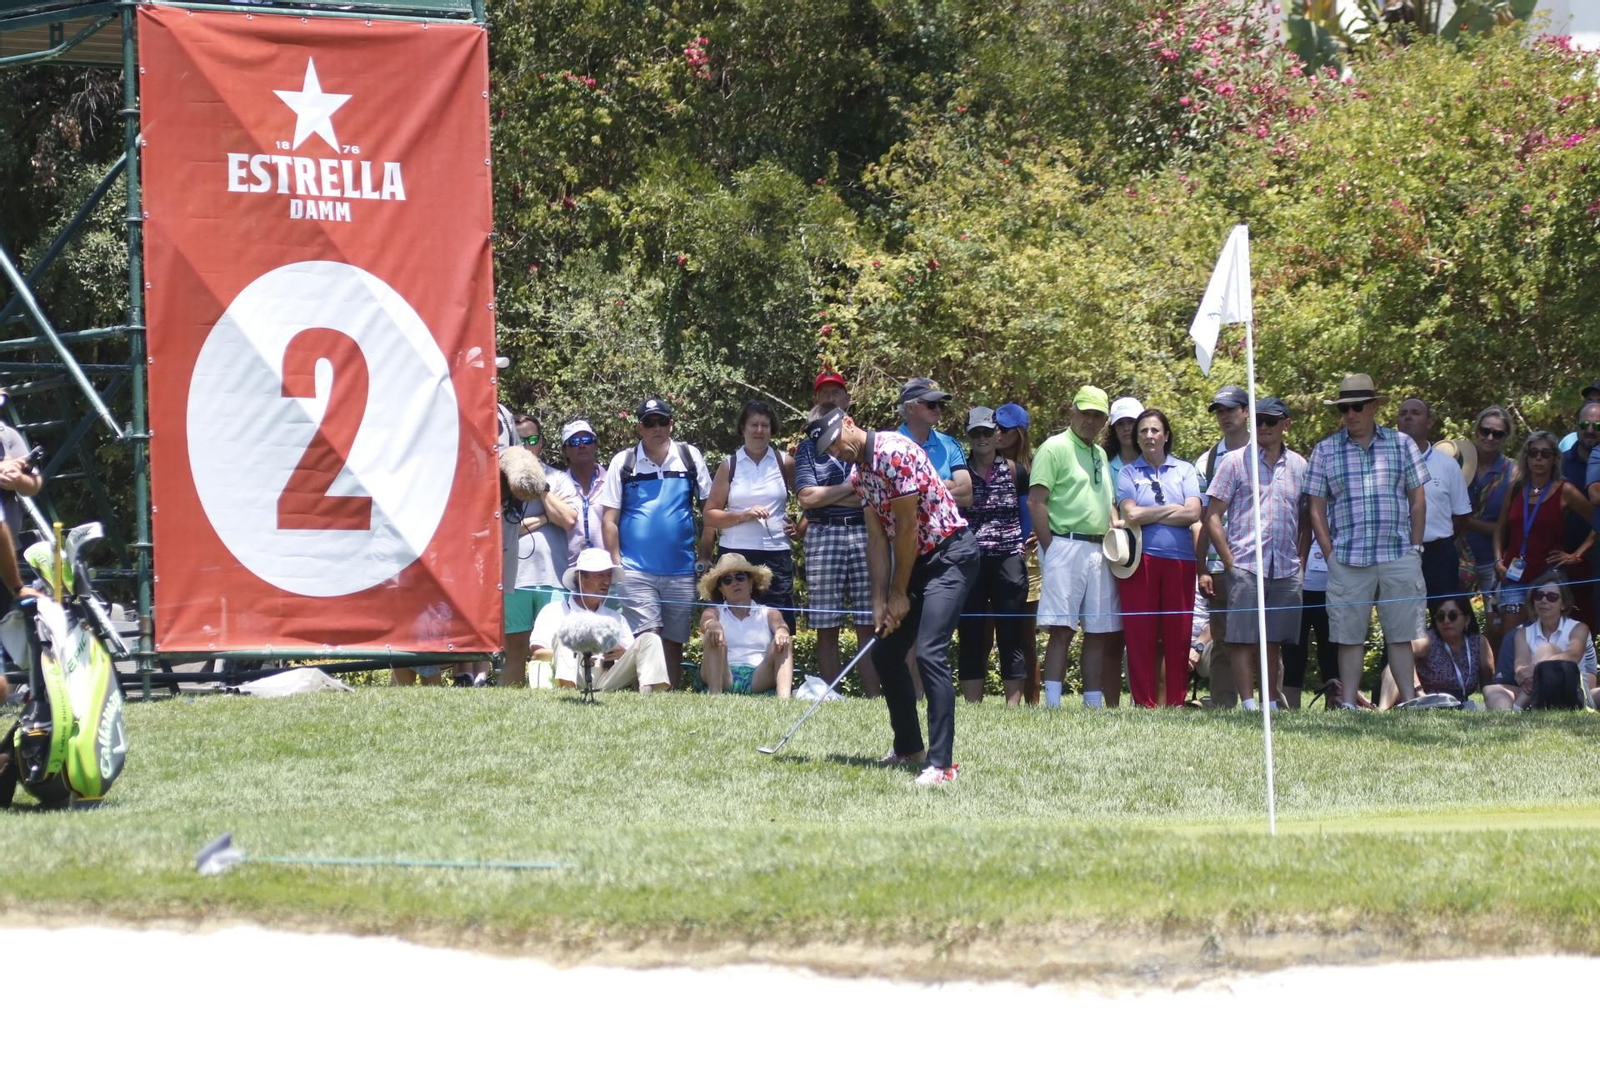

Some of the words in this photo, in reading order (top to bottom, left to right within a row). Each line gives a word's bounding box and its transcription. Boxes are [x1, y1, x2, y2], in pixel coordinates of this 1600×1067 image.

[275, 140, 290, 150] 18
[341, 145, 361, 155] 76
[227, 152, 407, 201] ESTRELLA
[289, 198, 352, 222] DAMM
[276, 326, 373, 531] 2
[66, 632, 88, 674] EPIC
